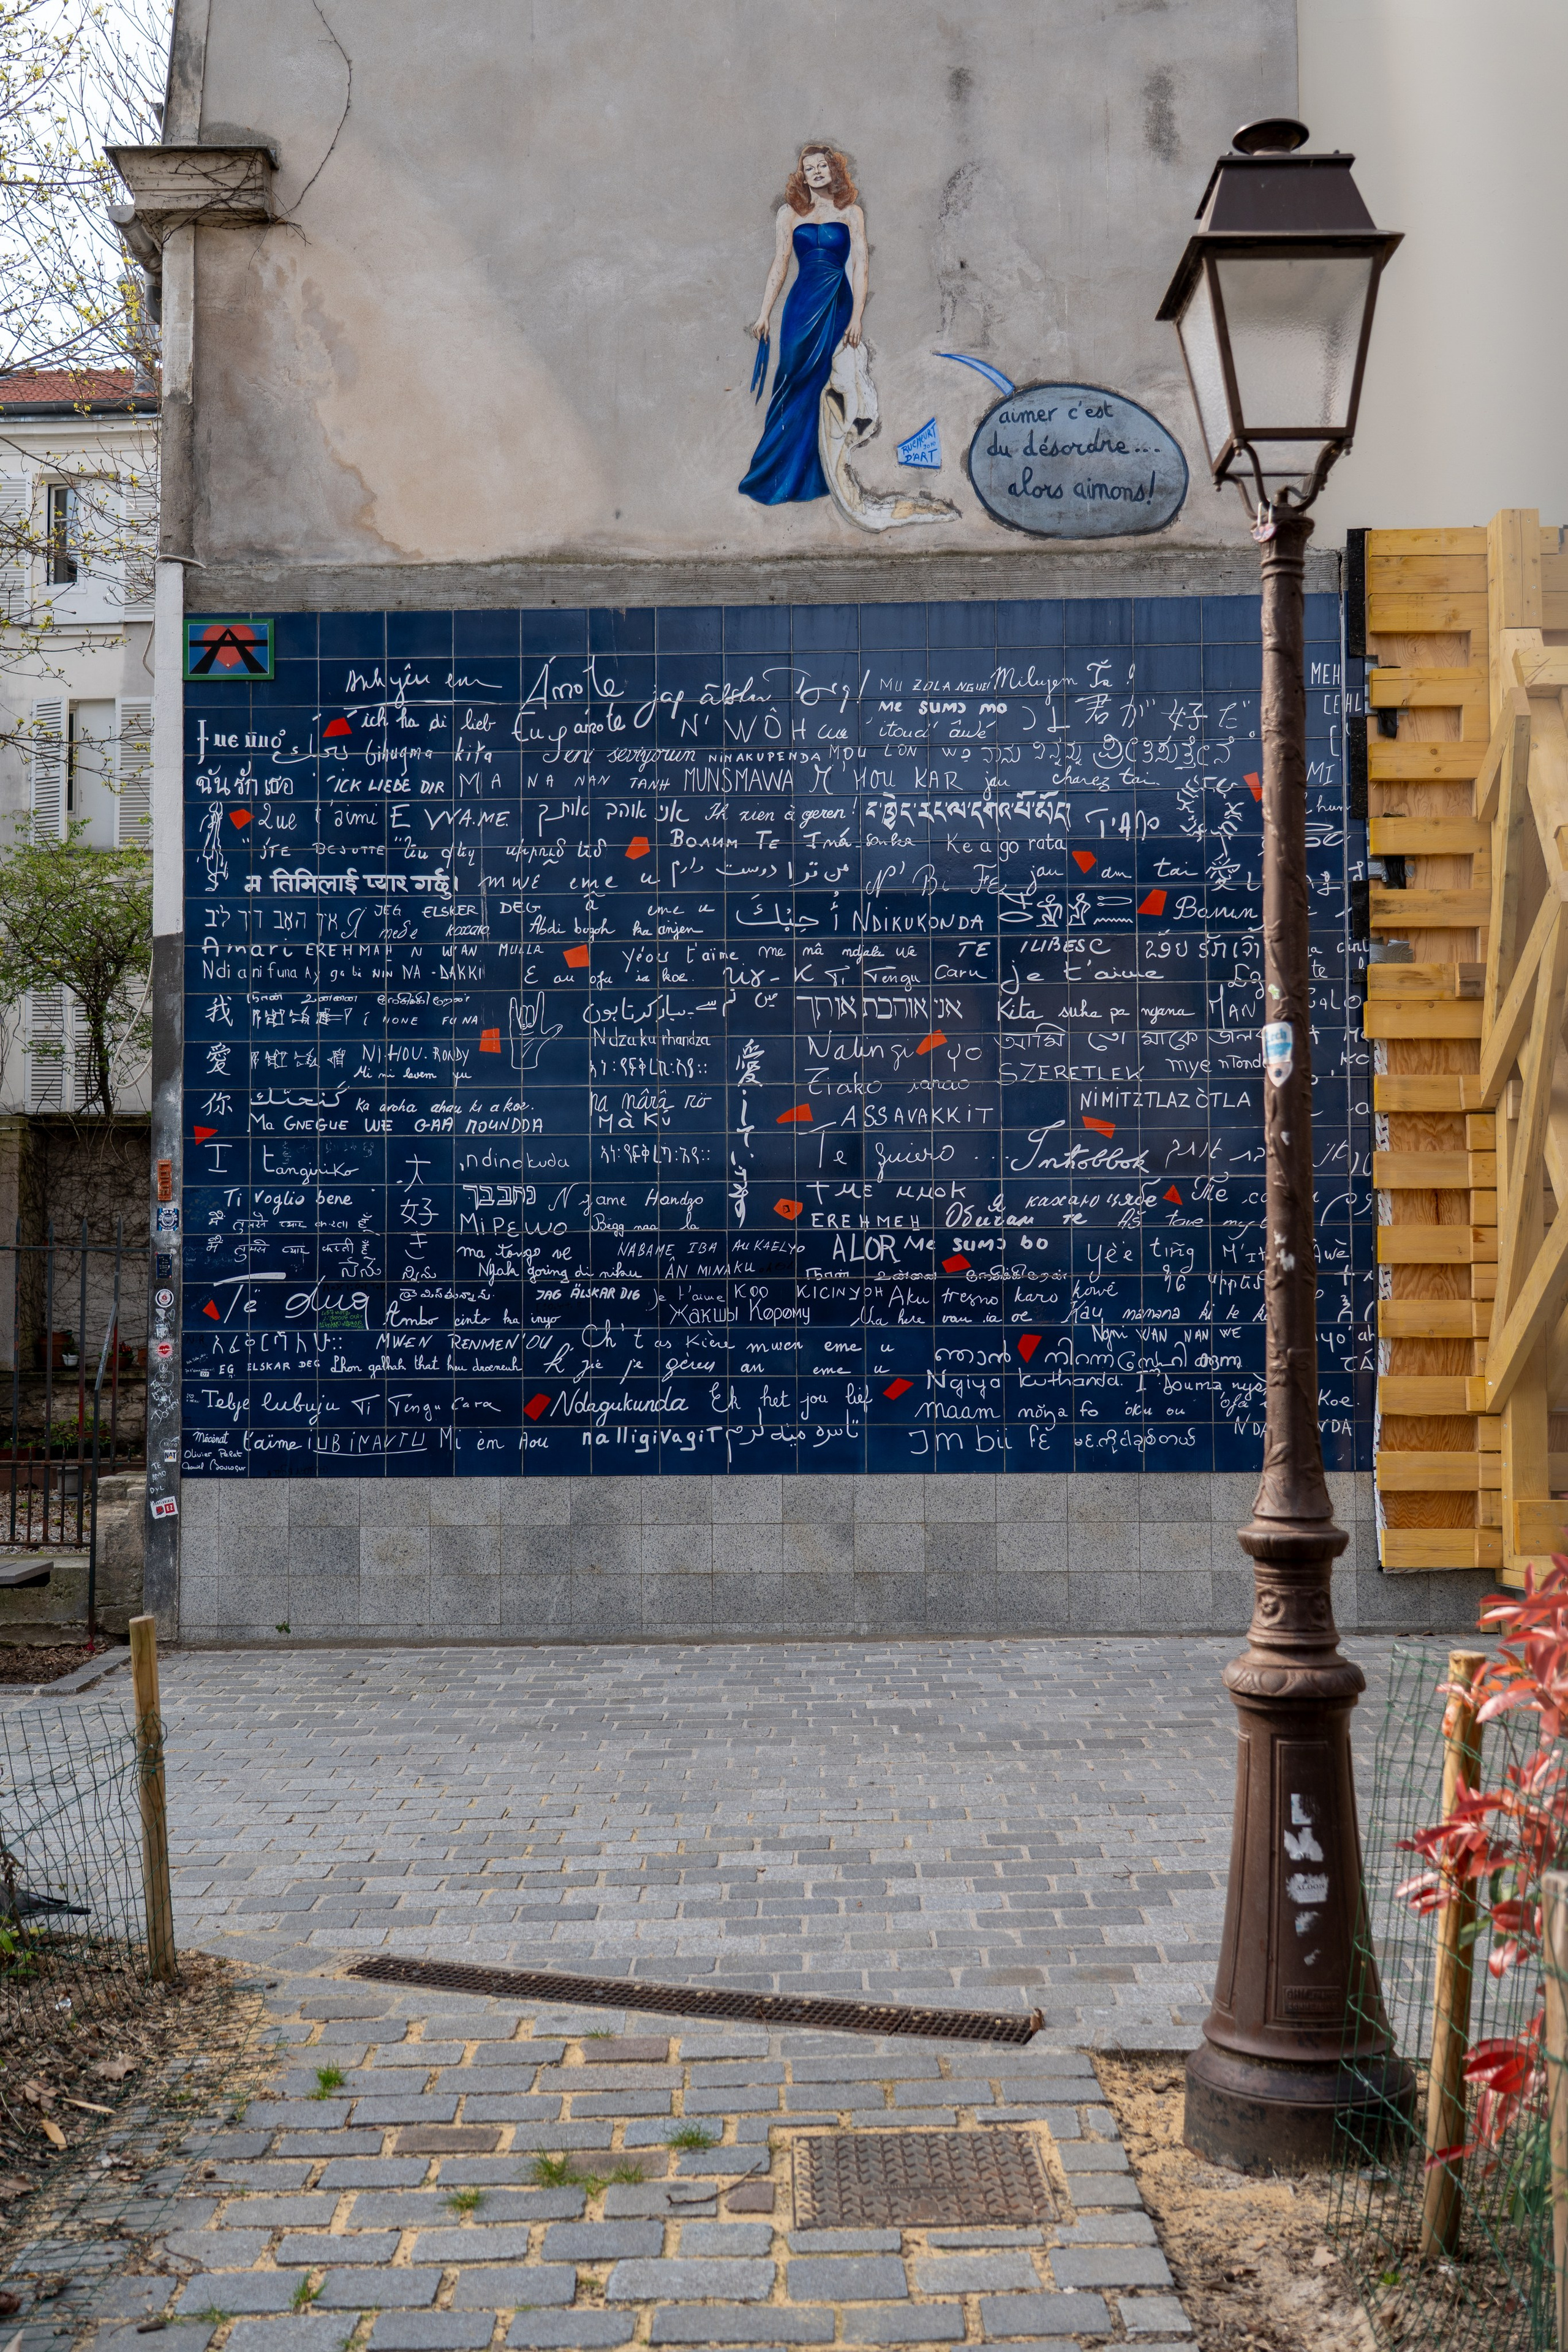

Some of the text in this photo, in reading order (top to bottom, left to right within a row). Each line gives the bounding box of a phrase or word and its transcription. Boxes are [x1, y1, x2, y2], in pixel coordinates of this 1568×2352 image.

[998, 399, 1114, 424] aimer c'est
[905, 448, 938, 463] D'ART
[986, 437, 1012, 458] du
[1008, 467, 1156, 505] alors aimons!
[368, 774, 411, 793] LIEBE
[420, 780, 445, 794] DIR
[421, 905, 478, 918] ELSKER
[500, 902, 541, 914] DEG
[315, 1189, 353, 1205] bene
[620, 1287, 640, 1300] DIG
[247, 1362, 290, 1371] ELSKAR
[184, 1449, 212, 1458] Olivier
